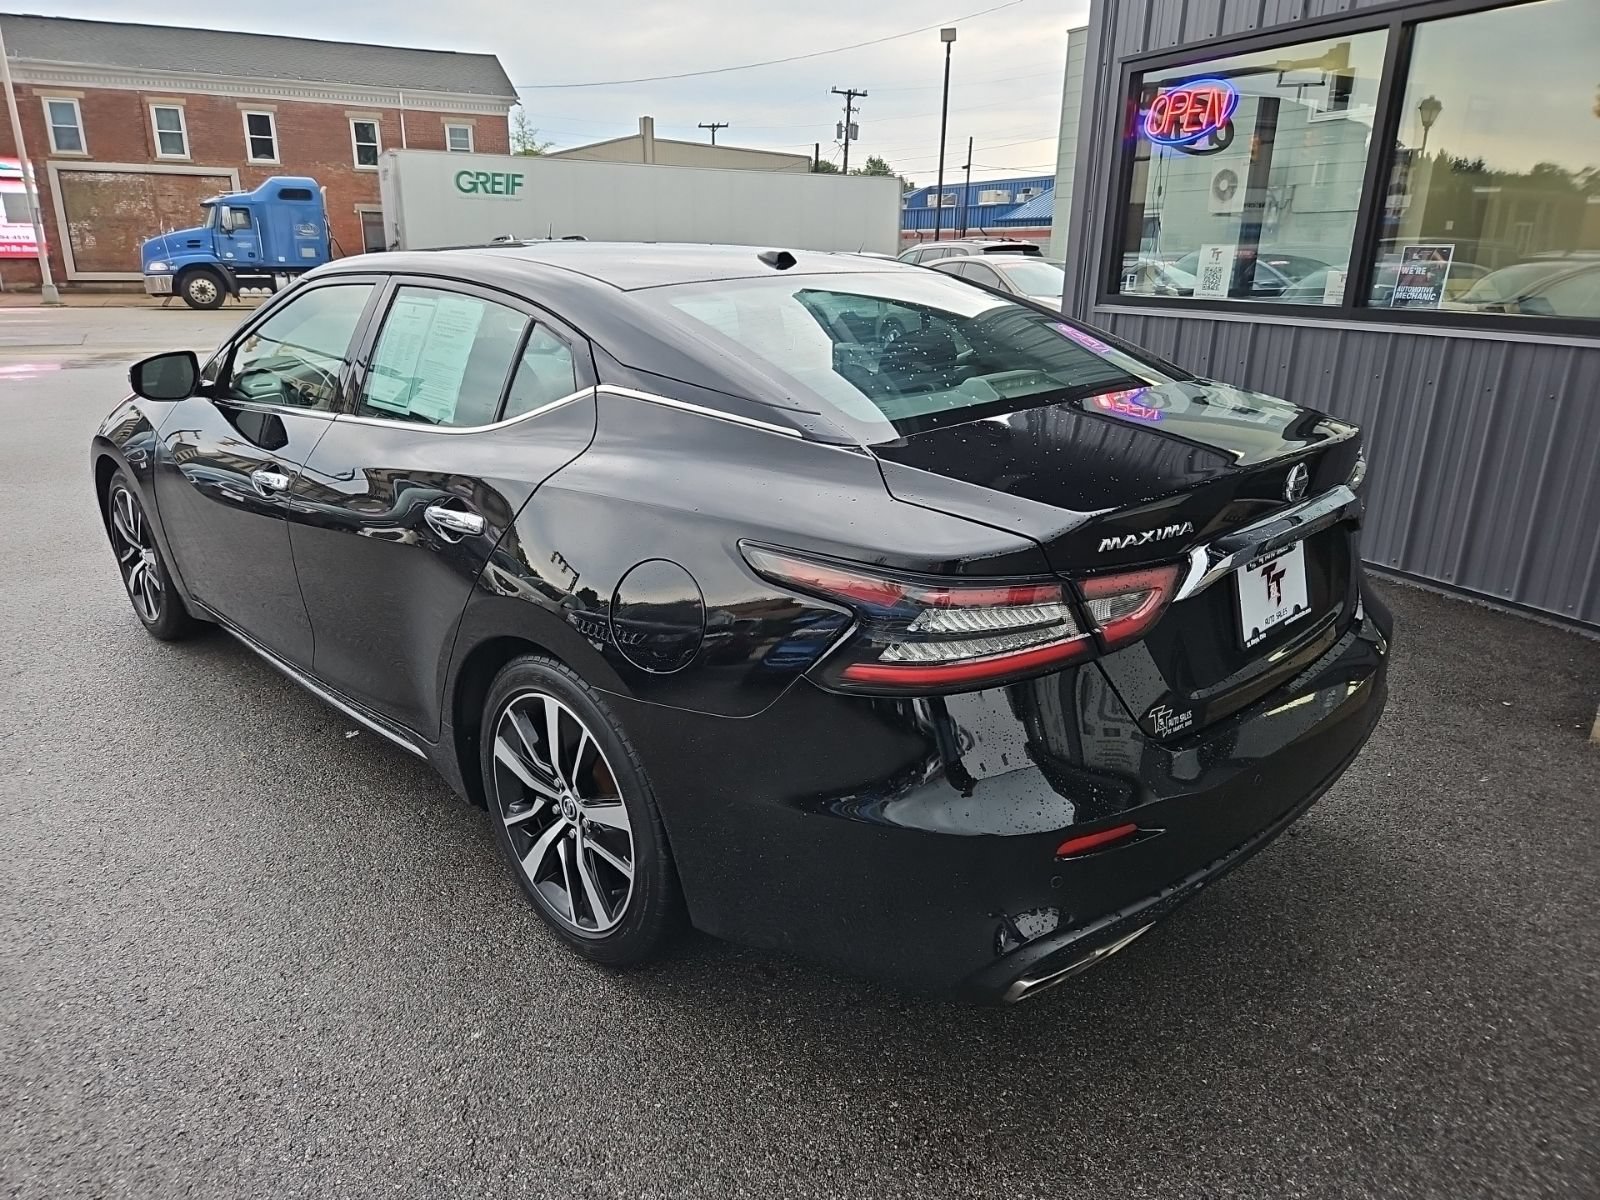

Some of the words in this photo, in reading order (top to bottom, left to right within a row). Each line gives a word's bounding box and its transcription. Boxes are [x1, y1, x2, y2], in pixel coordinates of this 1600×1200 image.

[1147, 88, 1231, 135] OPEN
[456, 170, 524, 195] GREIF
[1401, 266, 1427, 275] WE'RE
[1395, 292, 1436, 300] MECHANIC
[1098, 521, 1194, 552] MAXIMA
[1264, 615, 1275, 626] AUTO
[1276, 607, 1288, 621] SALES
